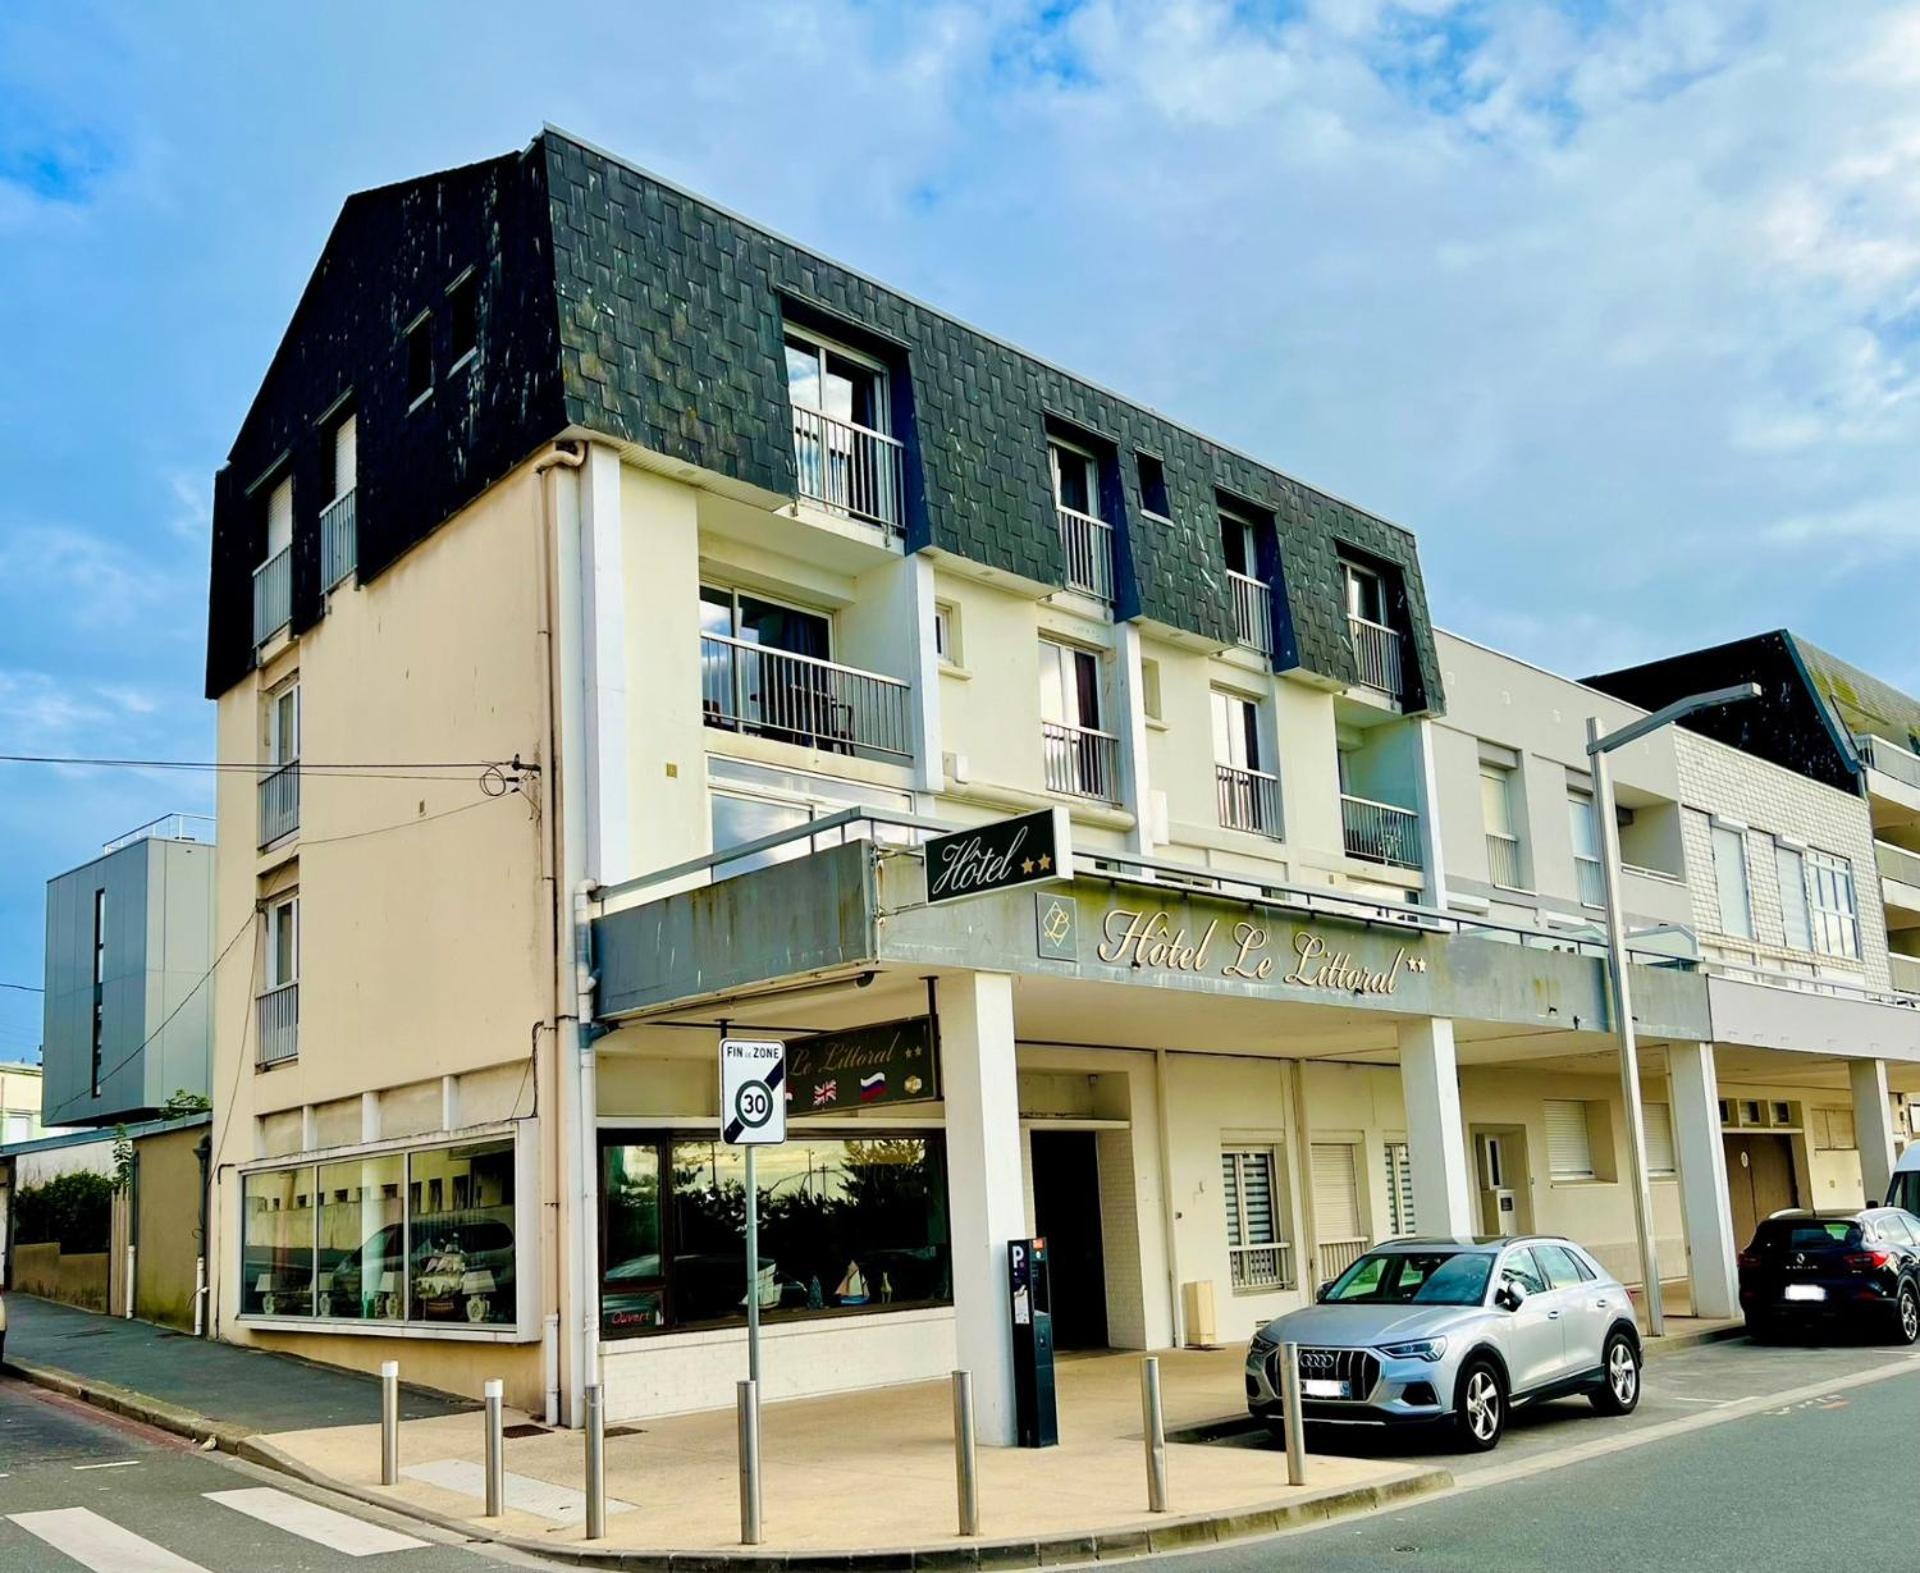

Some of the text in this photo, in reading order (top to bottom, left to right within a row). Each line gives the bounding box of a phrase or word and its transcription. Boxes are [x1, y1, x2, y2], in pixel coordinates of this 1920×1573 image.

[932, 825, 1029, 895] Hôtel
[1097, 909, 1405, 995] Hôtel Le Littoral
[726, 1046, 744, 1058] FIN
[753, 1047, 779, 1059] ZONE
[789, 1031, 901, 1077] Le Littoral
[743, 1094, 766, 1114] 30
[1012, 1246, 1024, 1269] P
